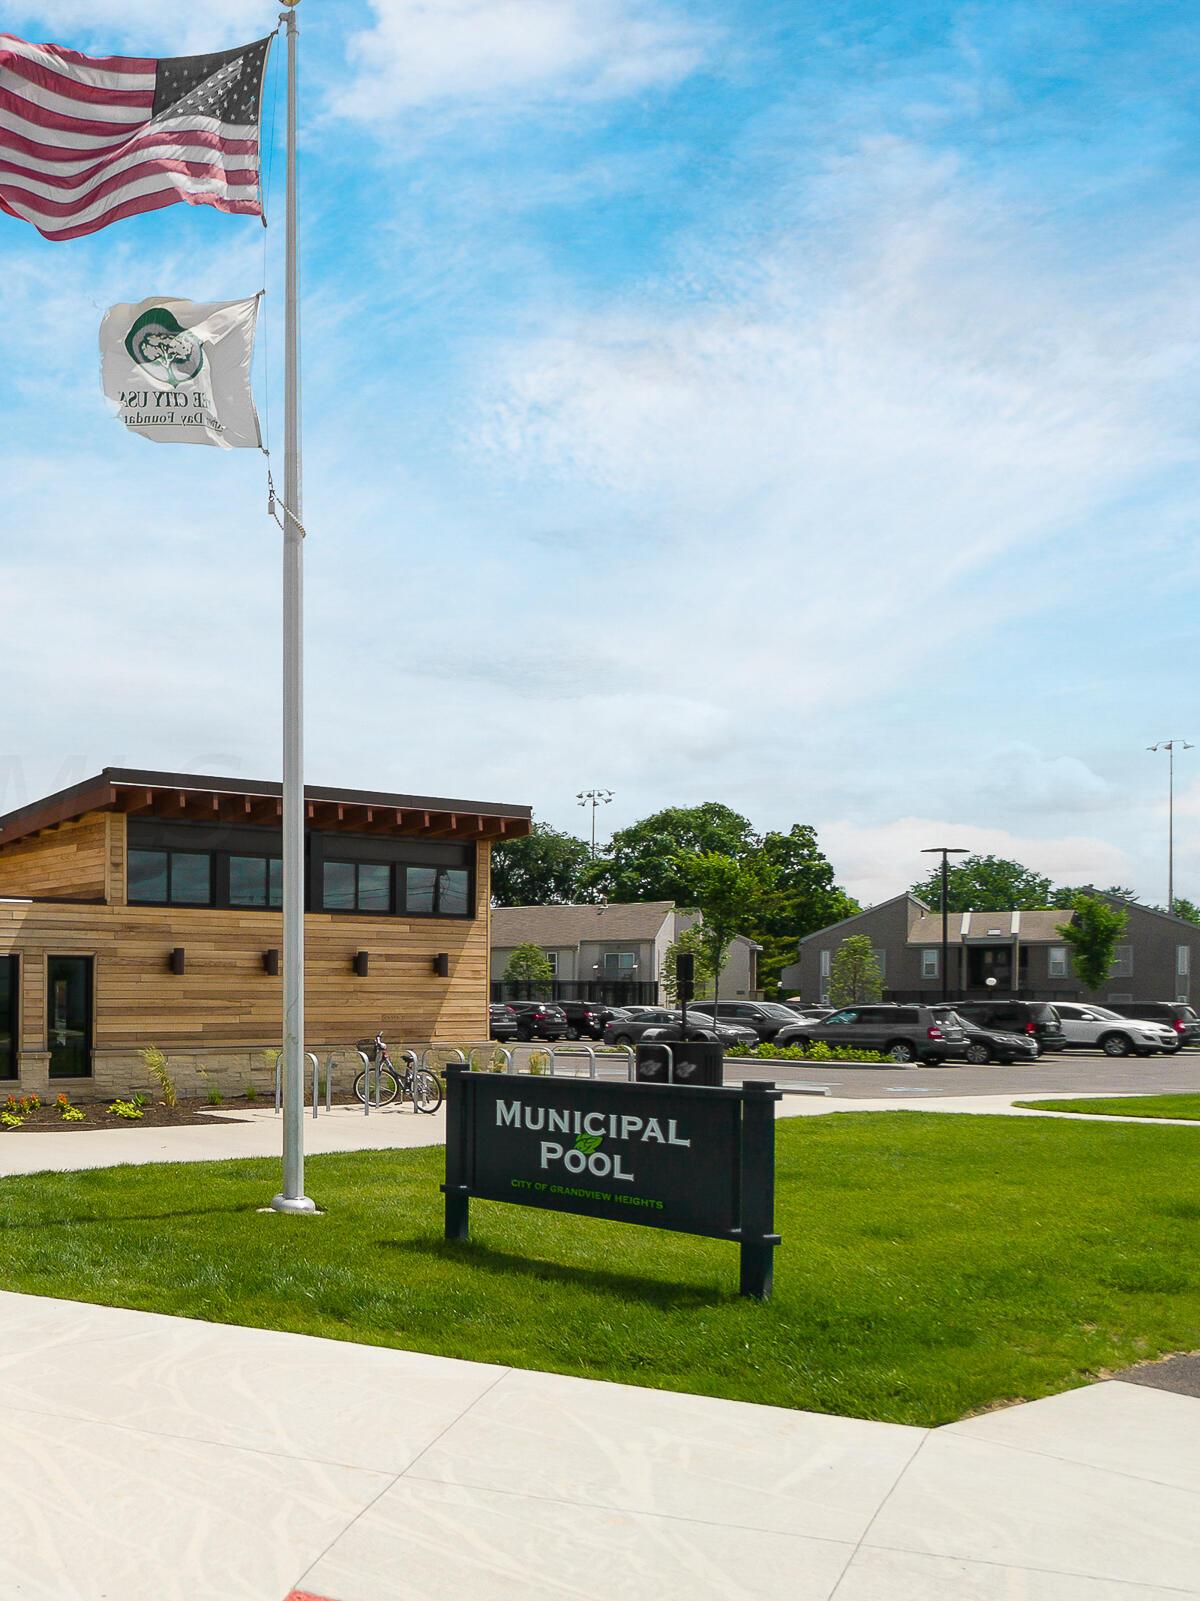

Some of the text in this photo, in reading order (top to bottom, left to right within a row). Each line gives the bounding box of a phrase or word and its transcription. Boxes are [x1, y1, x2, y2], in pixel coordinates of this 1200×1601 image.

[496, 1099, 691, 1148] MUNICIPAL
[540, 1141, 634, 1182] POOL
[511, 1179, 664, 1210] CITY OF GRANDVIEW HEIGHTS
